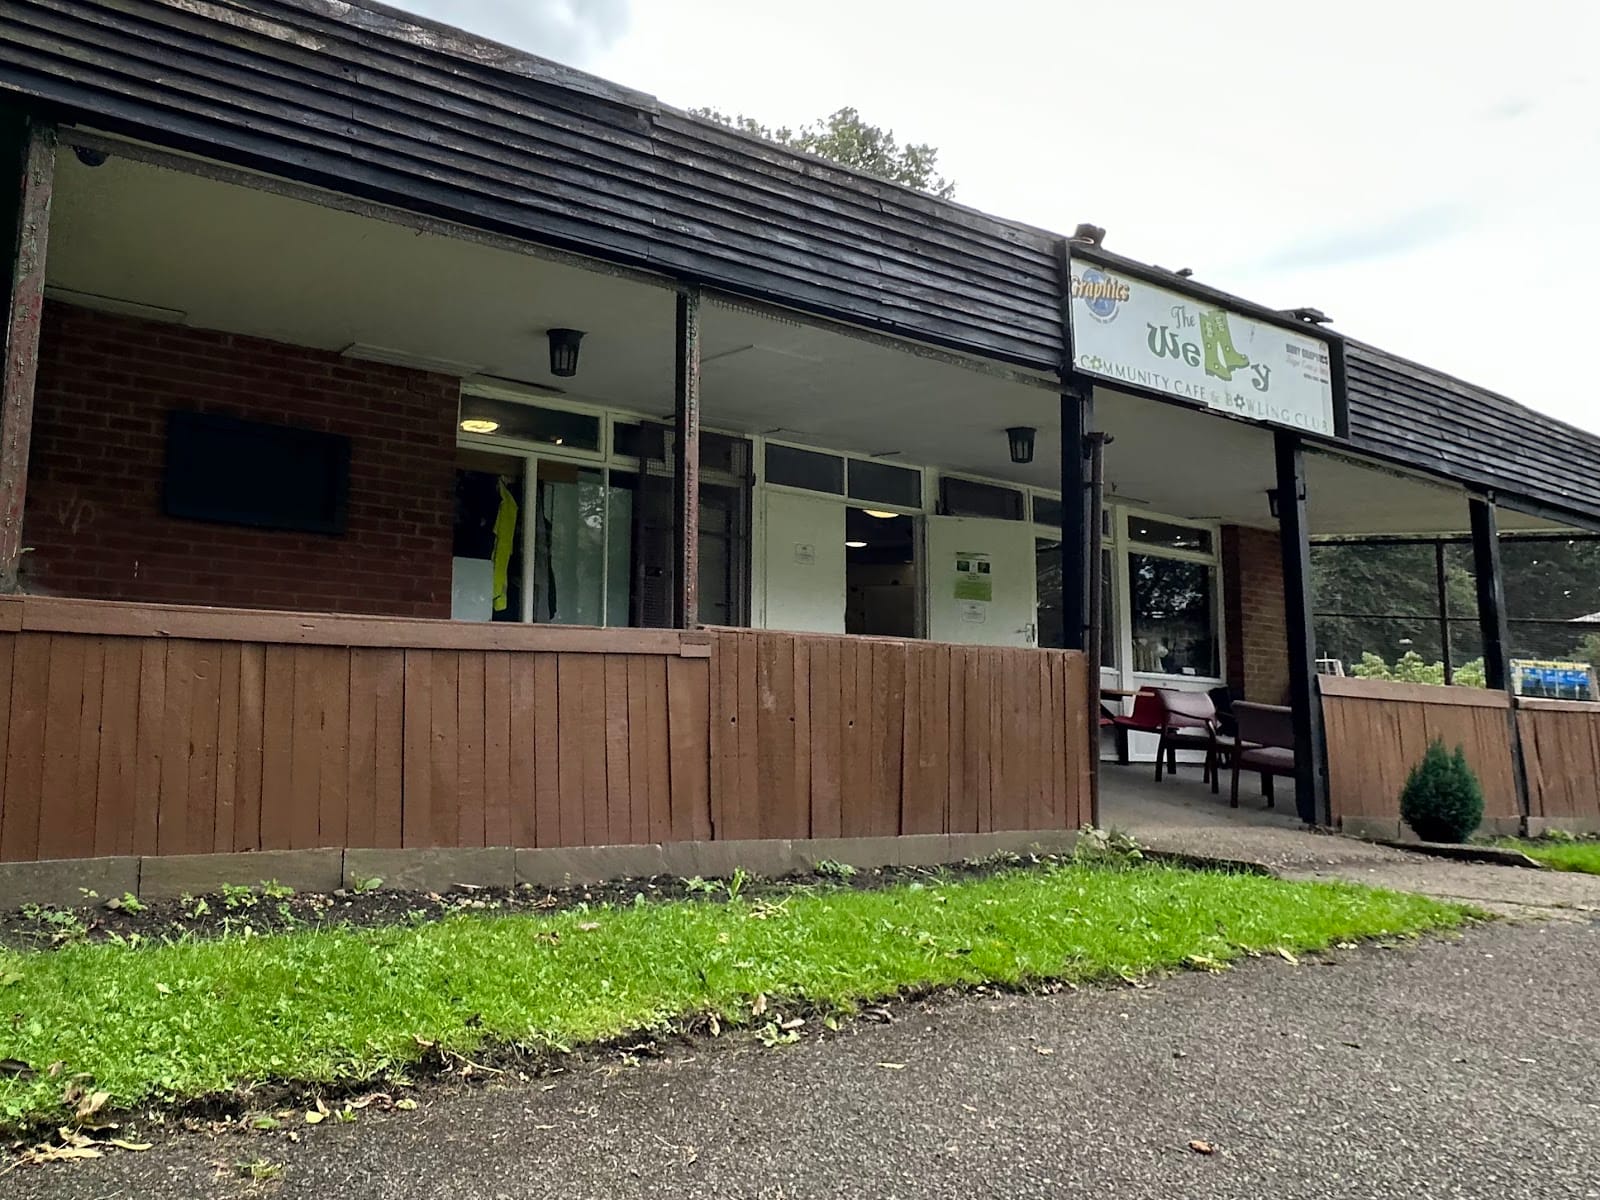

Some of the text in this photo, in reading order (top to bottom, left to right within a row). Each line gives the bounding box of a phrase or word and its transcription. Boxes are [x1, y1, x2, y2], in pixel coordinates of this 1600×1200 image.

[1171, 305, 1196, 329] The
[1080, 354, 1170, 389] COMMUNITY
[1174, 380, 1206, 401] CAFE
[1225, 390, 1290, 422] BOWLING
[1294, 413, 1328, 433] CLUB
